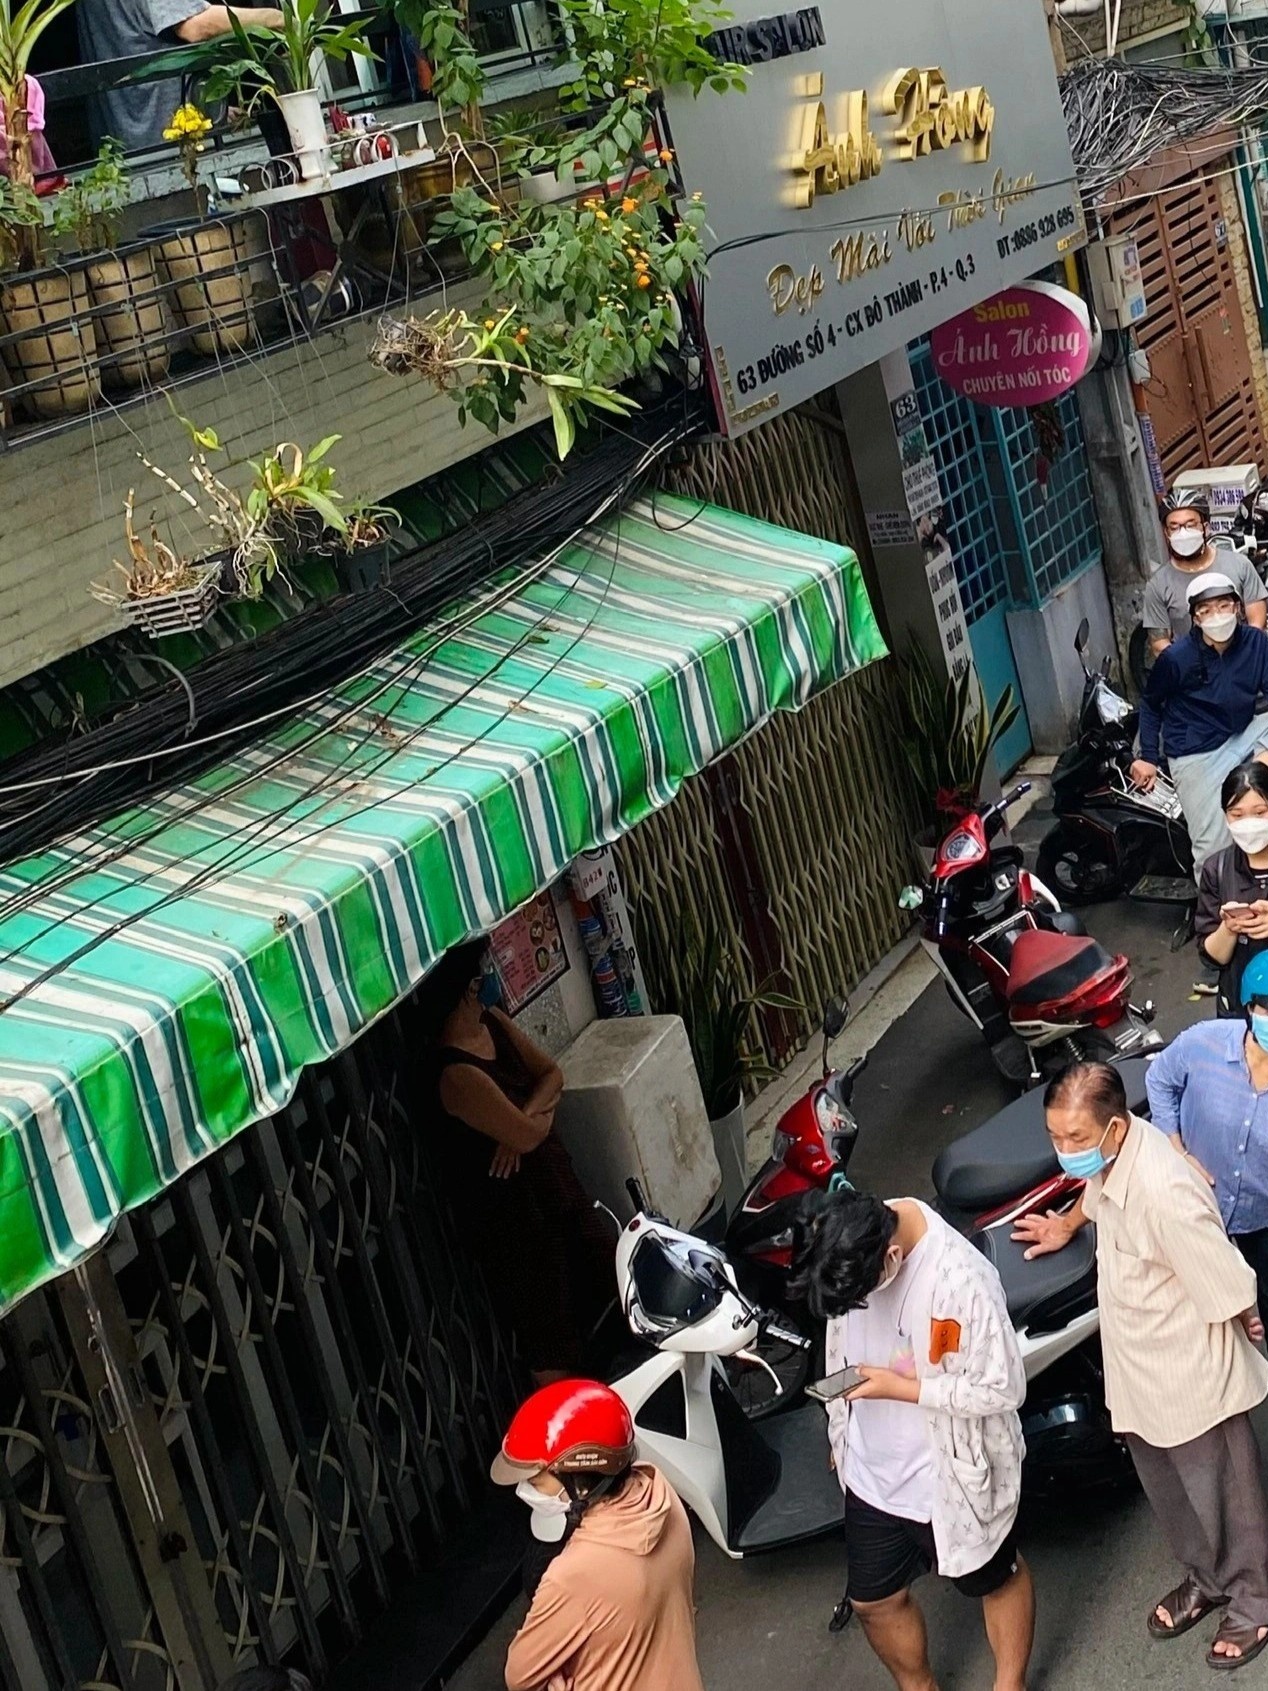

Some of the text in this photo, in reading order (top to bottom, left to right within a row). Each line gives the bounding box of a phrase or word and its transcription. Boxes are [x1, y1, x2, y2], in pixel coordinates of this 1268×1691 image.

[697, 6, 826, 65] AIR SALON
[766, 263, 825, 318] Đẹp
[973, 300, 1031, 322] Salon
[737, 366, 757, 394] 63
[757, 335, 805, 384] ĐƯỜNG
[806, 318, 824, 359] SỐ
[828, 323, 836, 347] 4
[845, 309, 864, 337] CX
[884, 278, 924, 317] THÀNH
[938, 323, 1084, 367] Ánh Hồng
[962, 363, 1072, 395] CHUYÊN NỐI TÓC
[895, 394, 916, 418] 63
